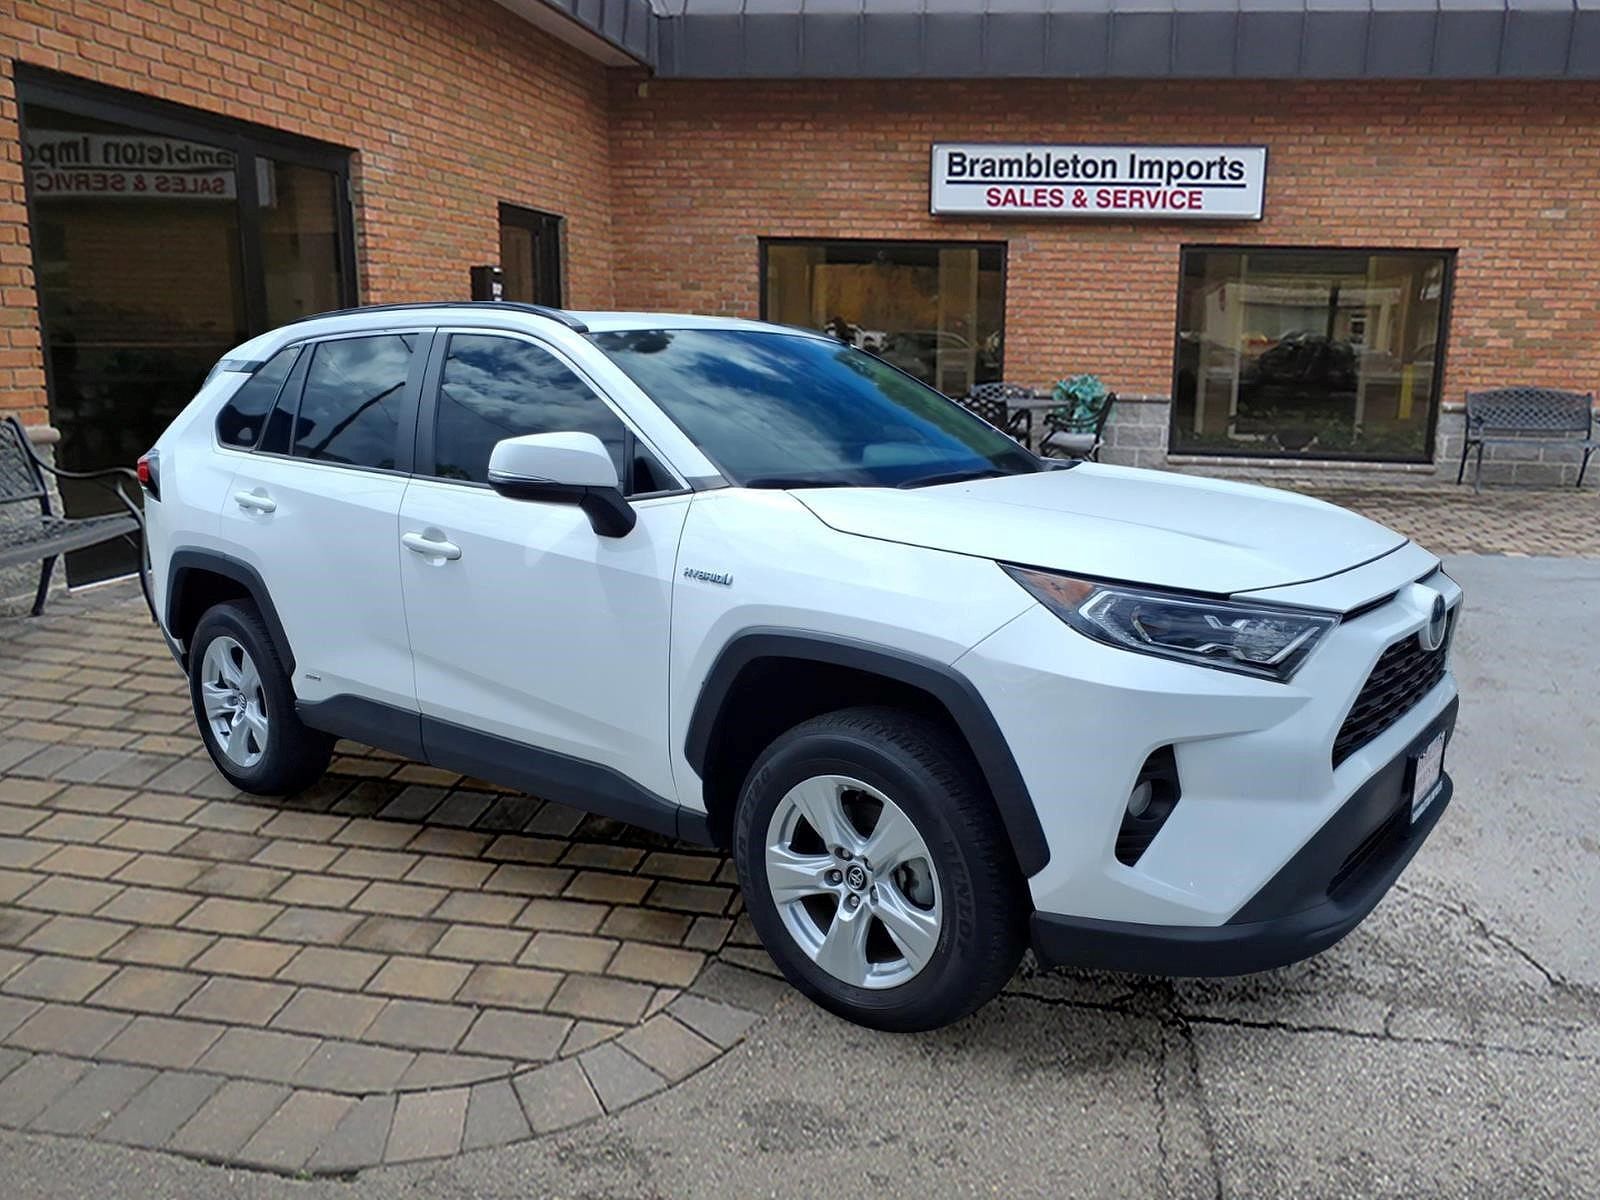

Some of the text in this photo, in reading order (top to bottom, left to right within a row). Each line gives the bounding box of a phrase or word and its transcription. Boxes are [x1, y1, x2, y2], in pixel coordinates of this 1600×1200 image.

[948, 151, 1245, 187] Brambleton Imports
[986, 187, 1203, 210] SALES & SERVICE
